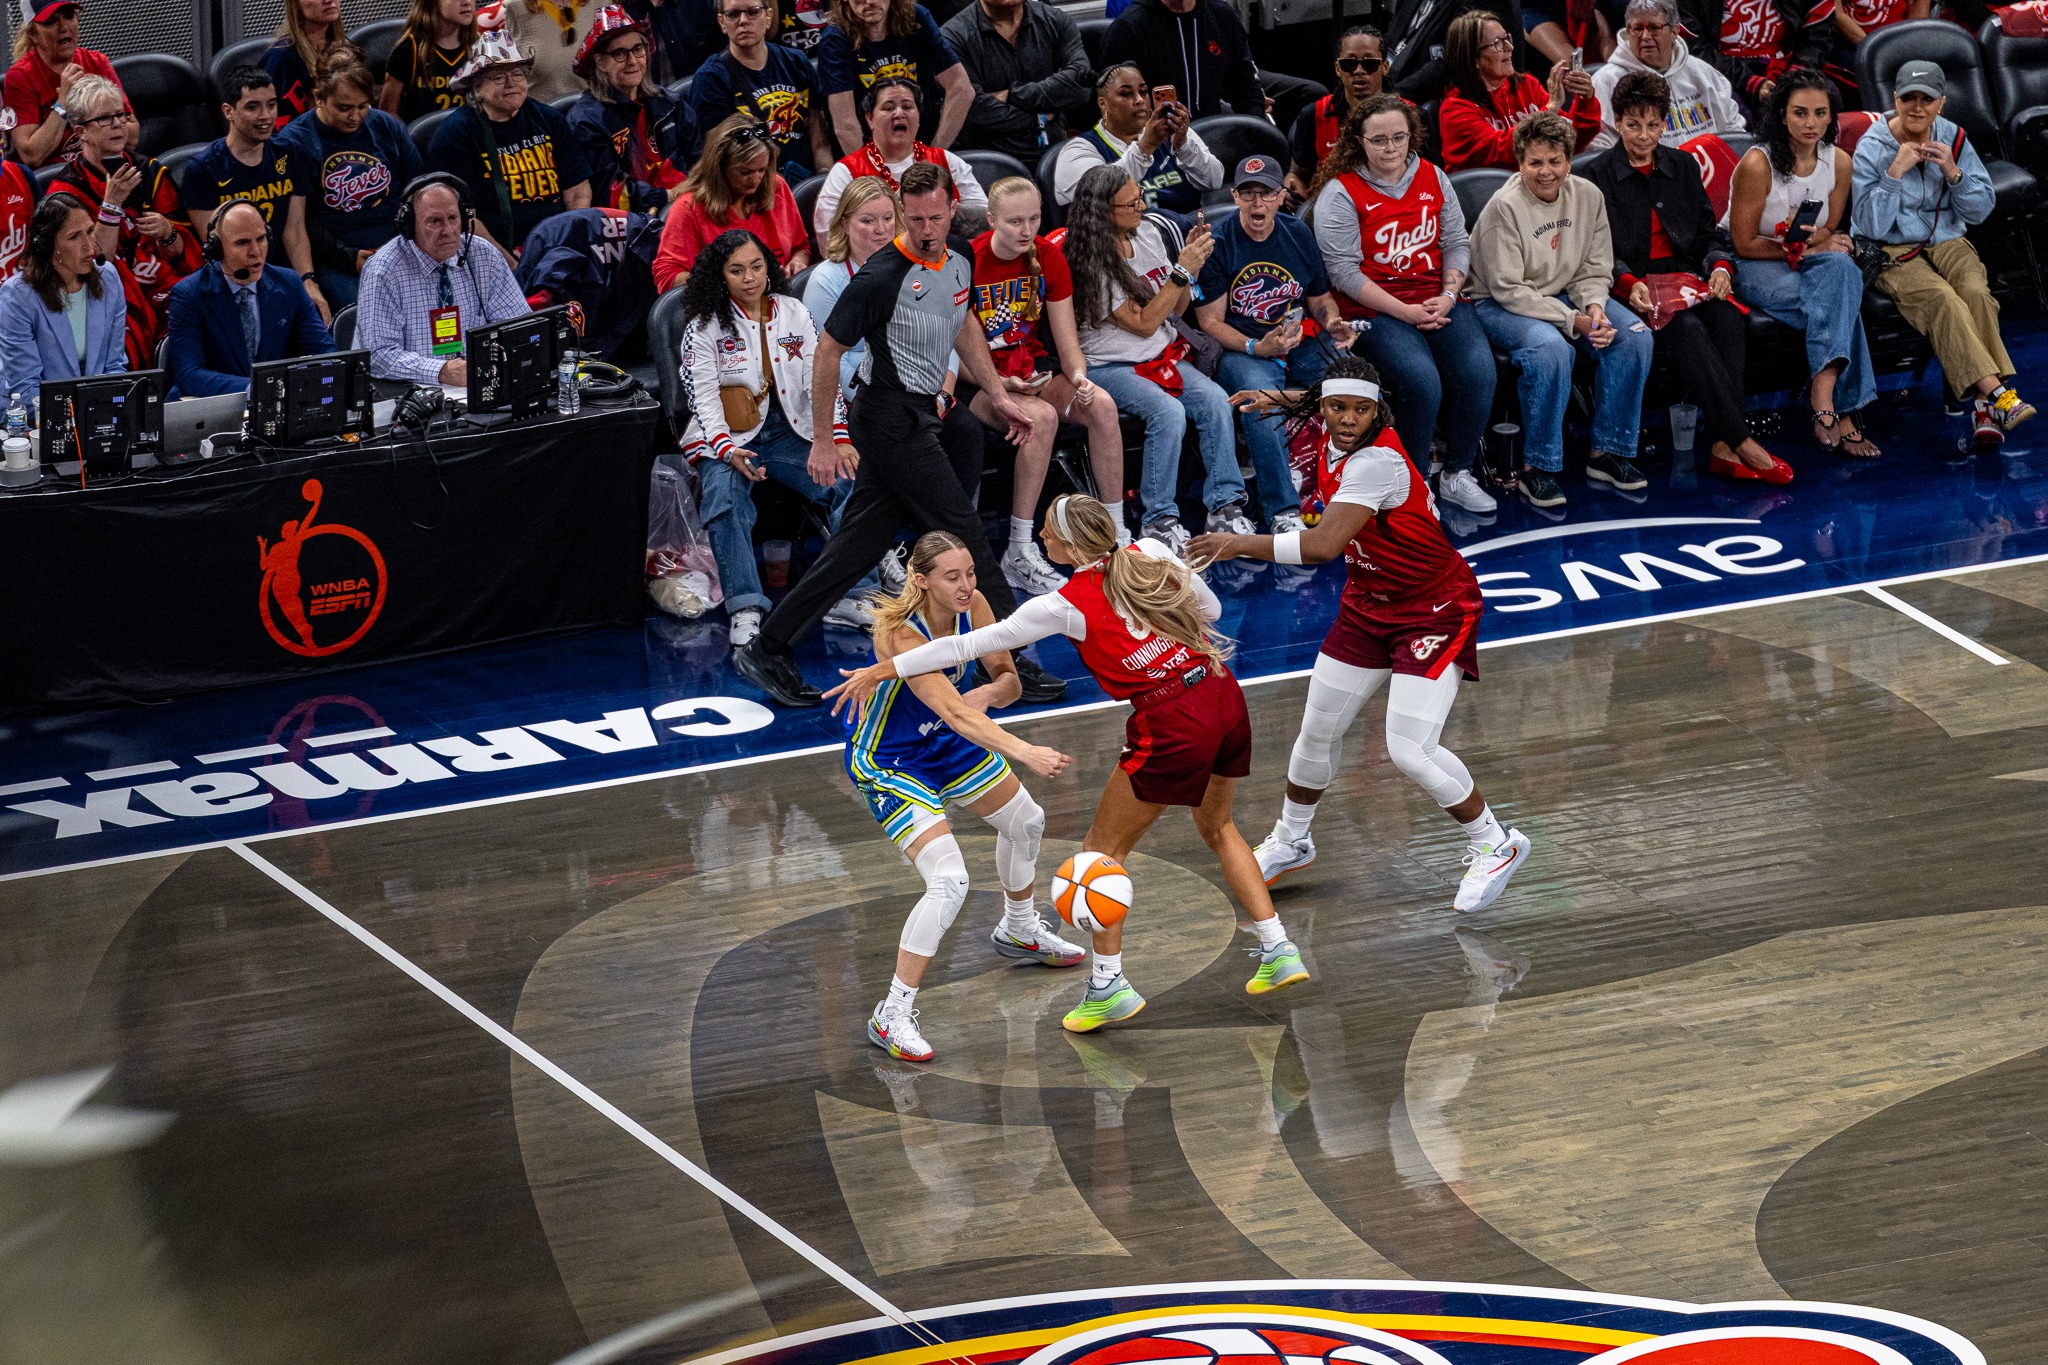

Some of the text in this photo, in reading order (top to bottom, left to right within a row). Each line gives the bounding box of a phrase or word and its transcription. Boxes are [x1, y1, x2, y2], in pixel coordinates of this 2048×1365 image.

[326, 154, 375, 174] INDIANA
[325, 163, 391, 208] Fever
[1374, 205, 1437, 264] Indy
[1532, 220, 1556, 240] INDIANA
[1238, 267, 1288, 286] INDIANA
[1477, 535, 1806, 612] aws
[310, 577, 370, 596] WNBA
[310, 591, 371, 616] ESPN
[1122, 636, 1178, 671] CUNNINGH
[1162, 647, 1190, 670] AT&T
